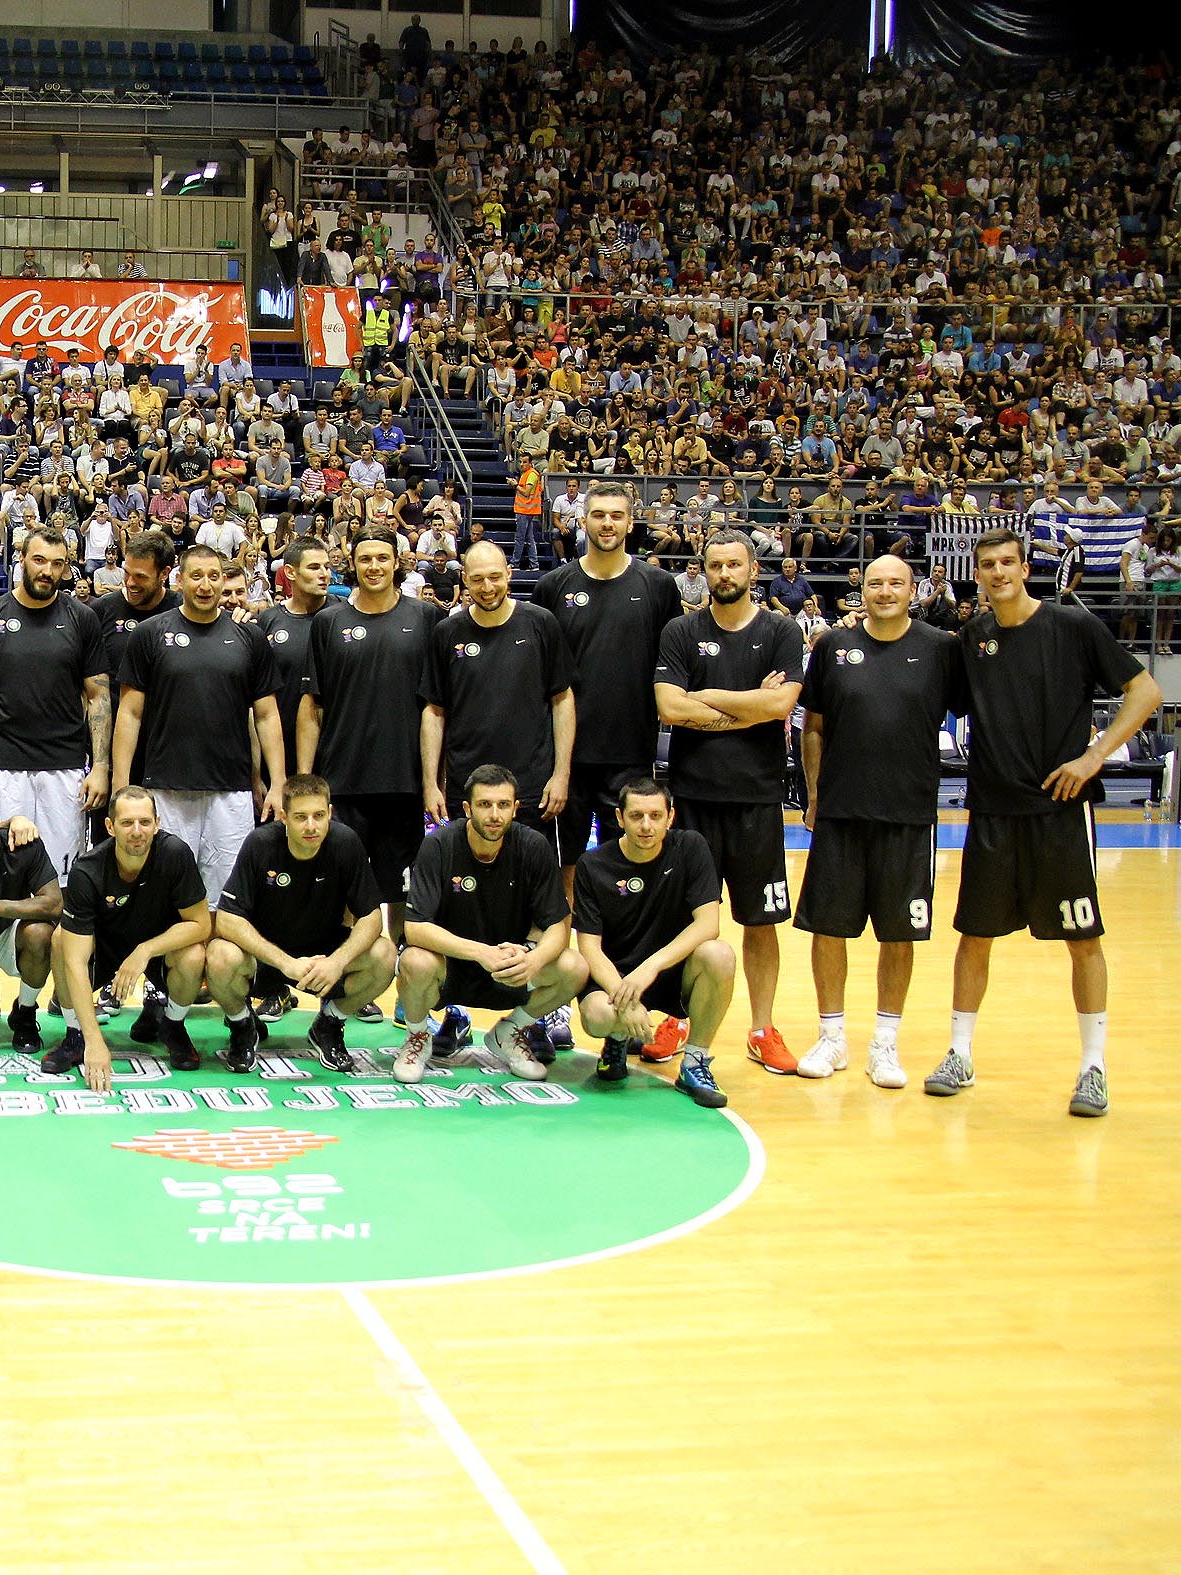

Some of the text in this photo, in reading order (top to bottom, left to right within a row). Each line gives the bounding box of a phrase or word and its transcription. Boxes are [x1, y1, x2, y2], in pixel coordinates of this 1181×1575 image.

[763, 880, 787, 912] 15
[909, 898, 929, 930] 9
[1059, 897, 1095, 930] 10
[196, 1196, 327, 1214] SRCE
[234, 1210, 309, 1227] NA
